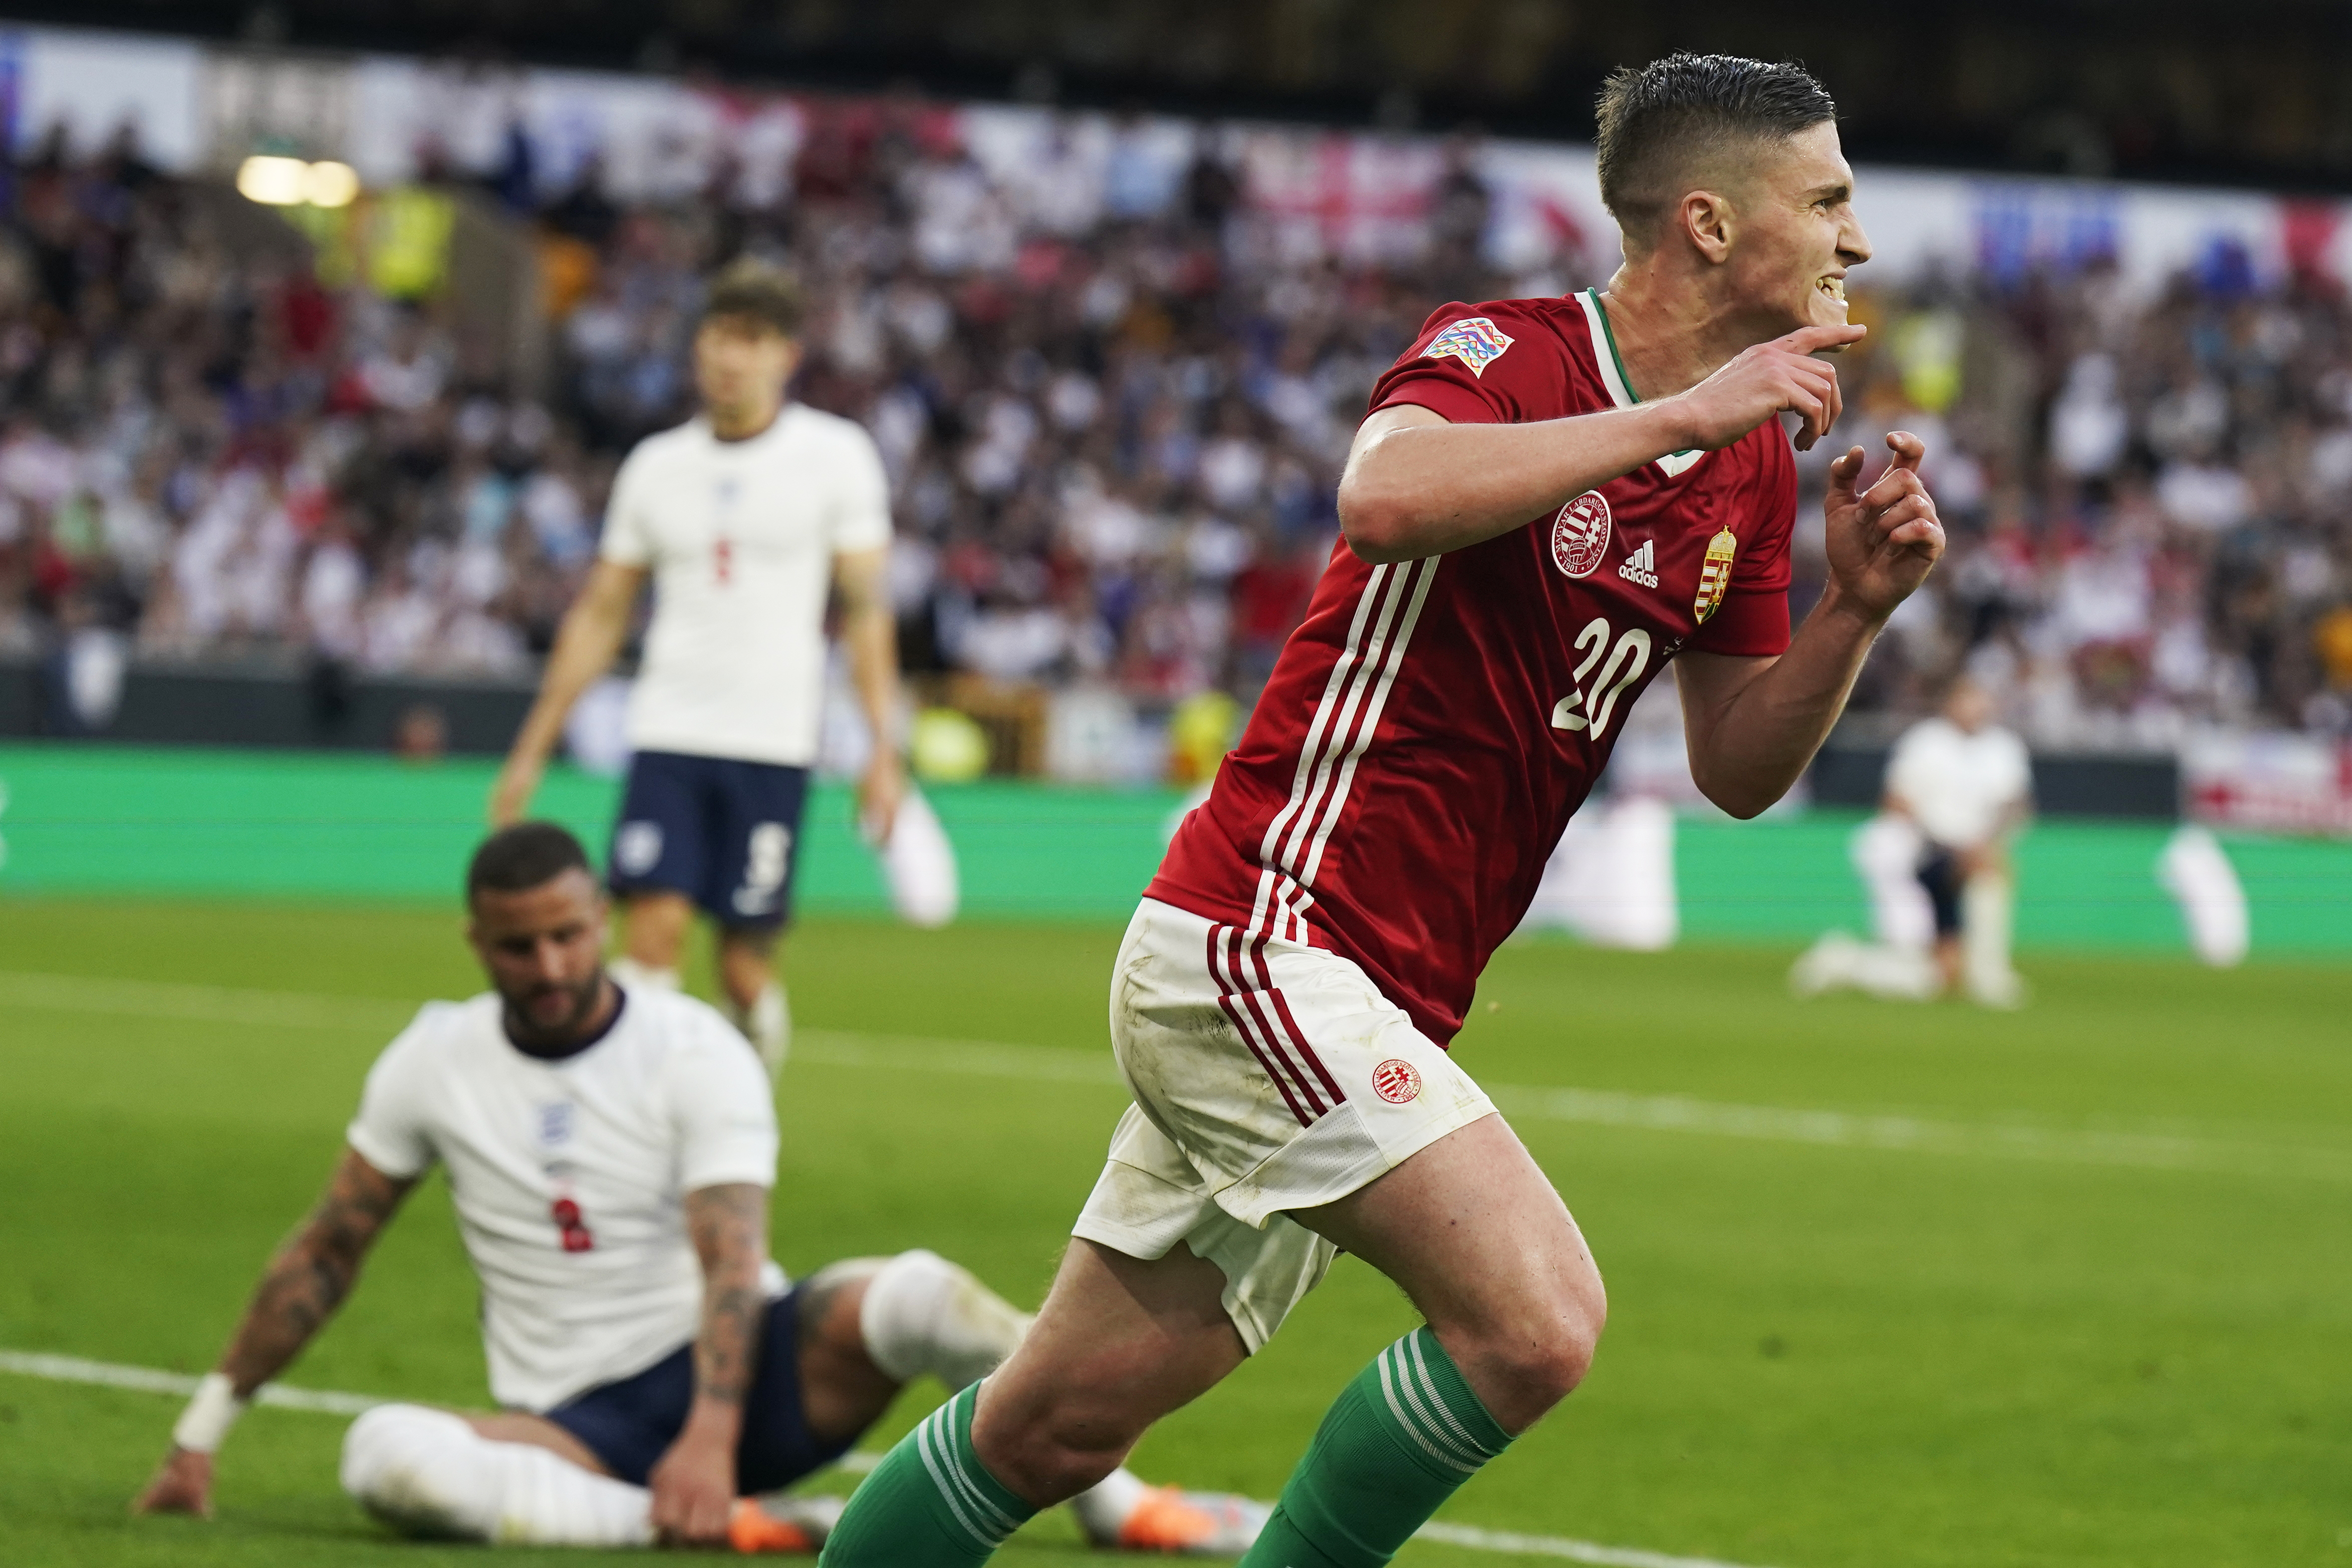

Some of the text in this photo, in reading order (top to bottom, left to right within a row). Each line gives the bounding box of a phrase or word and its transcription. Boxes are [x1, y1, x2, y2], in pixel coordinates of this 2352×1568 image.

[1555, 512, 1570, 553] MAGYAR
[1562, 560, 1578, 573] 1901
[1618, 565, 1658, 589] adidas
[1551, 617, 1651, 741] 20
